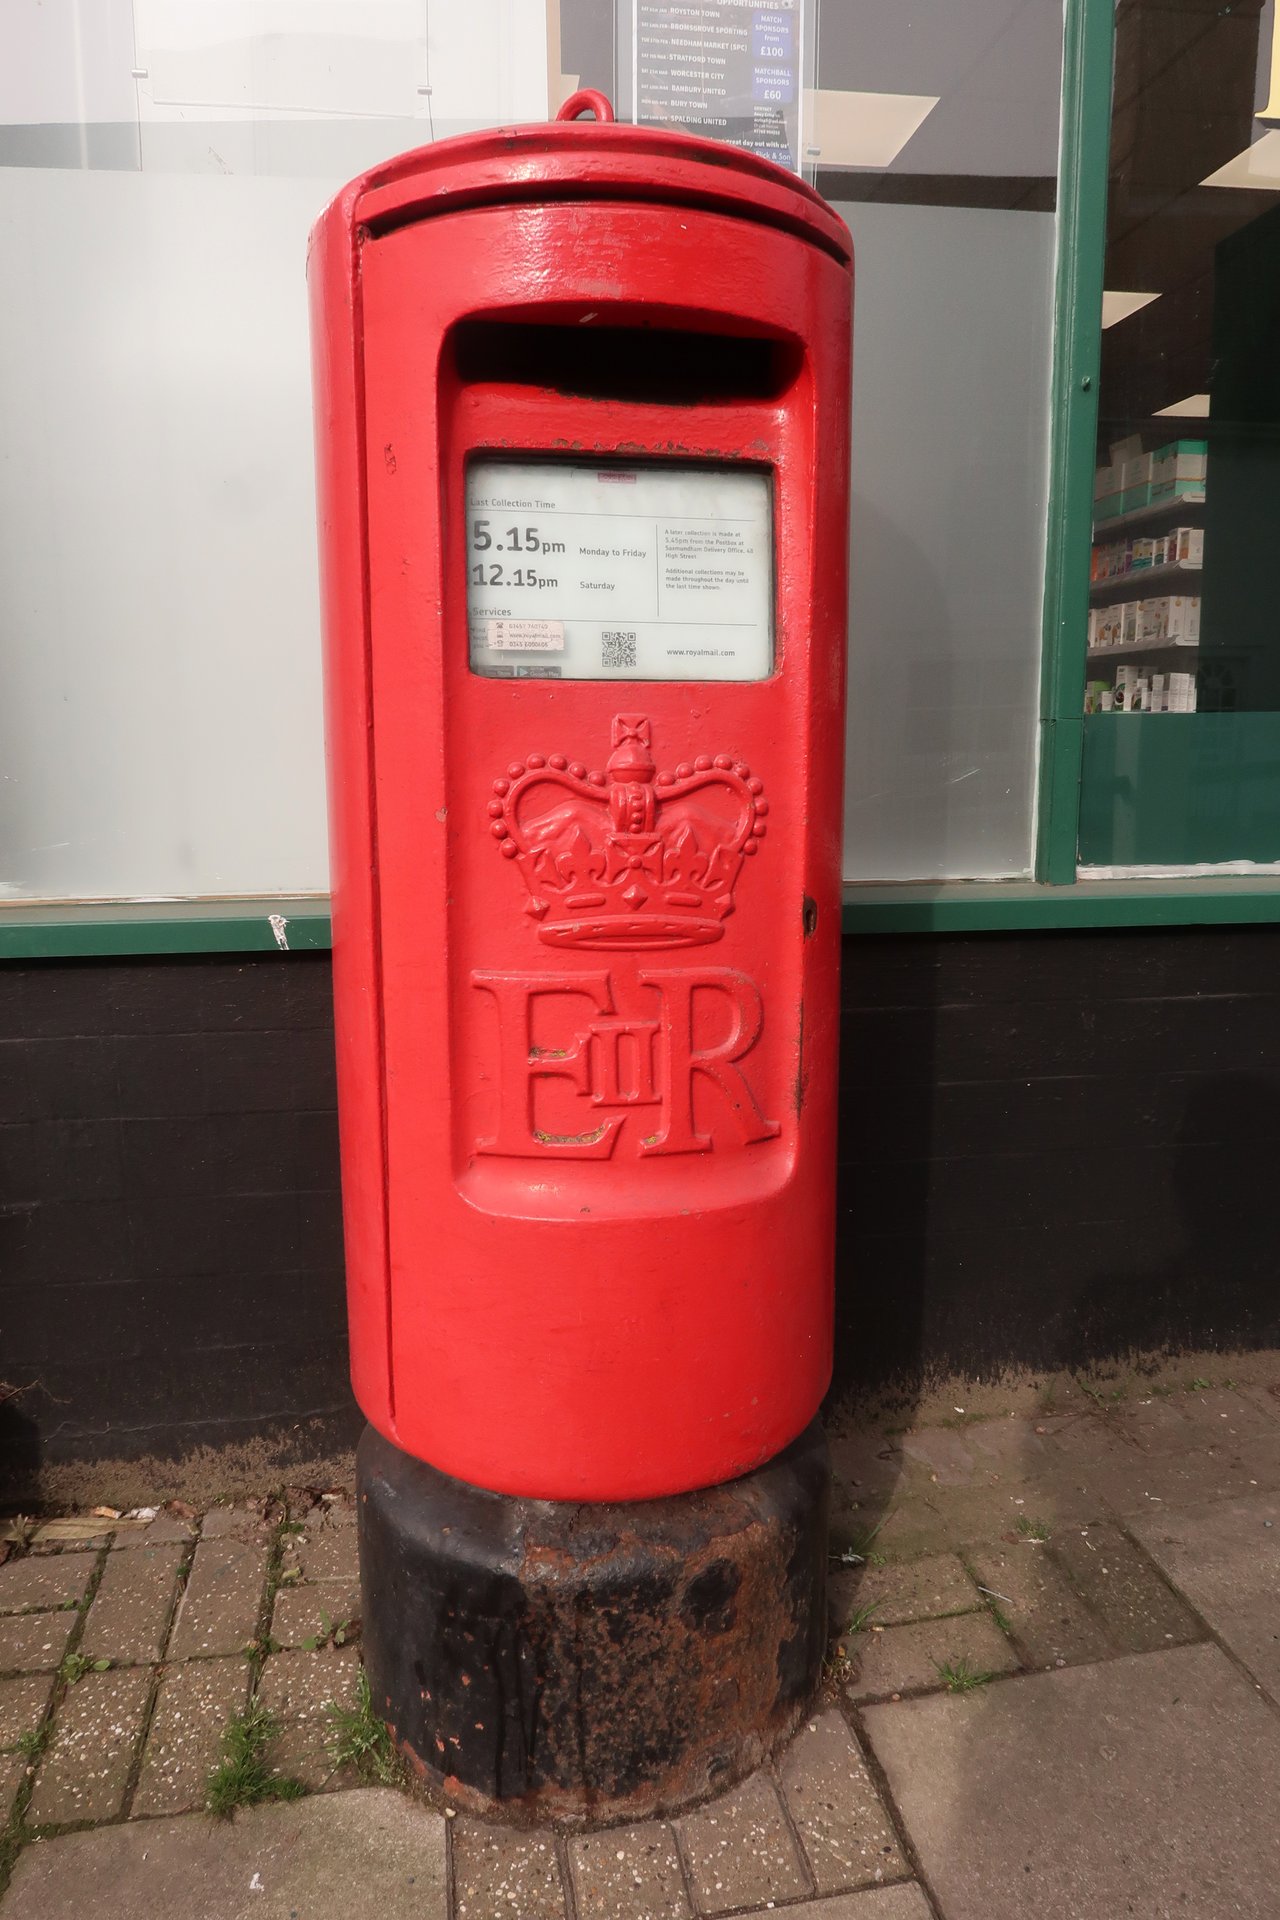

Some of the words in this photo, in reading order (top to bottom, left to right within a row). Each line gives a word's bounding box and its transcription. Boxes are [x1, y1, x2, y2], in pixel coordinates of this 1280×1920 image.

[716, 0, 779, 10] OPPORTUNITIES
[670, 7, 700, 16] ROYSTON
[701, 10, 720, 18] TOWN
[760, 15, 783, 24] MATCH
[670, 23, 714, 33] BROMSGROVE
[716, 27, 748, 36] SPORTING
[754, 24, 789, 33] SPONSORS
[671, 38, 702, 47] NEEDHAM
[703, 42, 729, 50] MARKET
[760, 46, 784, 57] £100
[669, 54, 706, 63] STRATFORD
[707, 57, 727, 66] TOWN
[670, 69, 710, 79] WORCESTER
[754, 67, 791, 77] MATCHBALL
[756, 77, 790, 86] SPONSORS
[671, 85, 701, 93] BANBURY
[702, 88, 727, 96] UNITED
[763, 90, 782, 100] £60
[670, 99, 688, 108] BURY
[689, 101, 708, 109] TOWN
[670, 114, 702, 124] SPALDING
[703, 118, 727, 126] UNITED
[742, 139, 754, 148] day
[778, 153, 791, 161] Son
[470, 498, 489, 507] Last
[491, 498, 533, 508] Collection
[535, 500, 556, 509] Time
[473, 520, 566, 555] 5.15pm
[579, 547, 610, 557] Monday
[612, 548, 620, 556] to
[623, 549, 647, 558] Friday
[703, 546, 726, 554] Delivery
[665, 552, 678, 560] High
[472, 563, 558, 590] 12.15pm
[682, 576, 714, 584] throughout
[580, 581, 615, 591] Saturday
[473, 608, 512, 617] Services
[667, 648, 735, 658] www.royalmail.com
